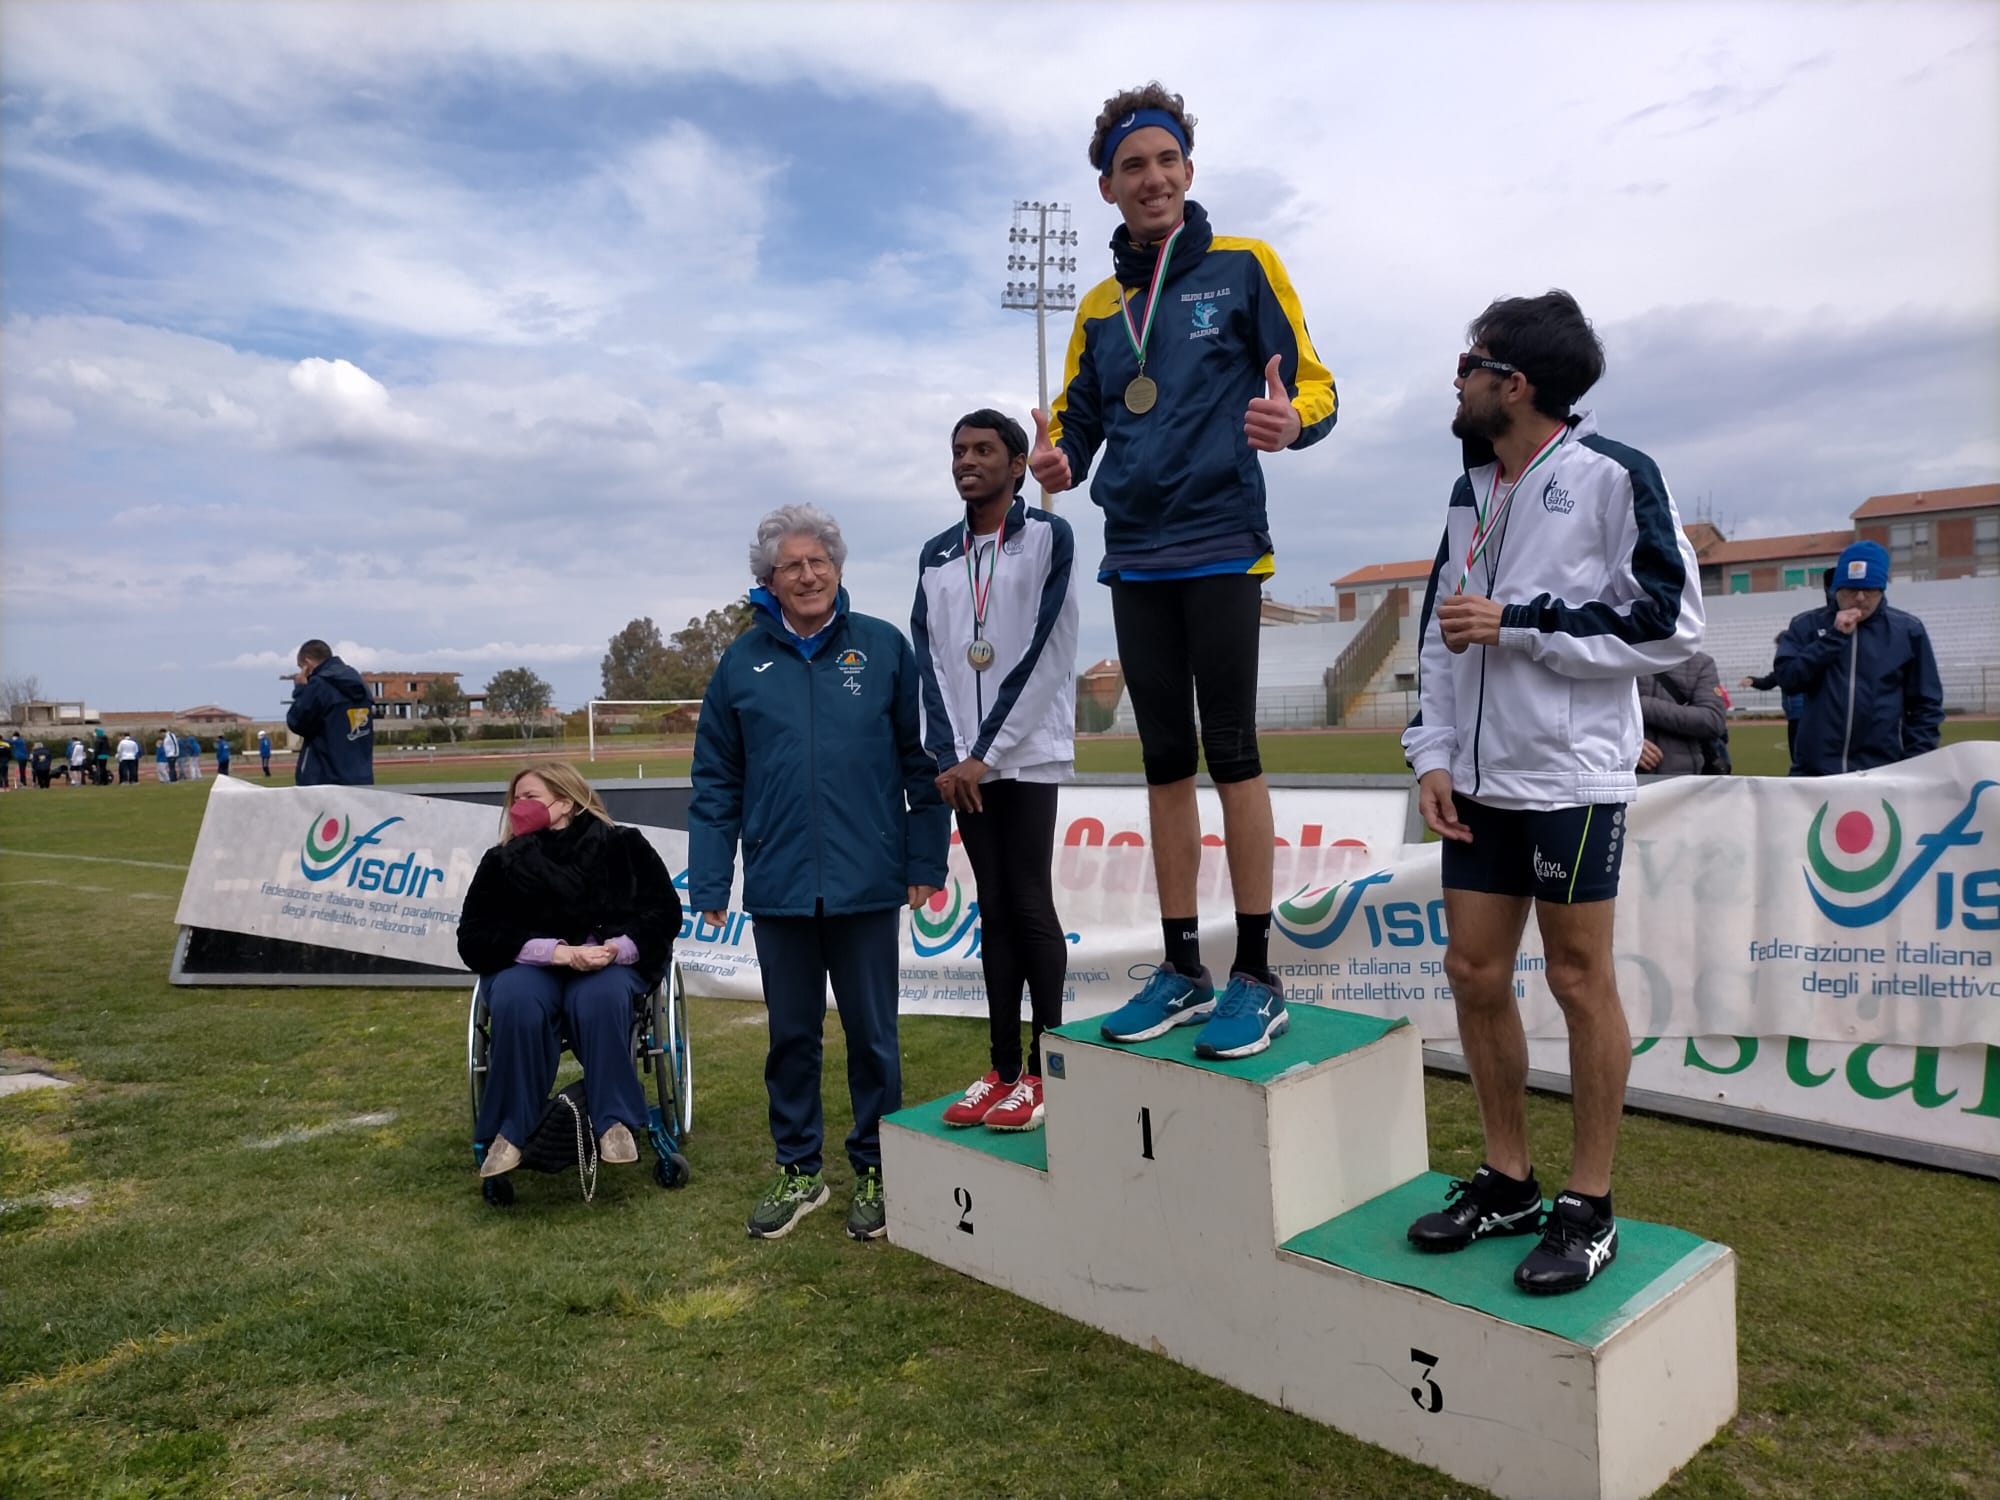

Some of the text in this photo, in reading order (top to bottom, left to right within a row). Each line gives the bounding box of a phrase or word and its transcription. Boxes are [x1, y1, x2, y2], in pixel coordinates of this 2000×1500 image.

[260, 881, 323, 903] federazione
[326, 891, 365, 909] italiana
[369, 900, 399, 915] sport
[281, 902, 427, 936] degli intellettivo relazionali
[1347, 957, 1411, 976] italiana
[1749, 937, 1993, 968] federazione italiana
[933, 984, 985, 1001] intelletti
[1284, 983, 1323, 1004] degli
[1331, 982, 1425, 1001] intellettivo
[1801, 970, 1859, 999] degli
[1136, 1105, 1156, 1162] 1
[952, 1185, 975, 1236] 2
[1409, 1346, 1444, 1415] 3
